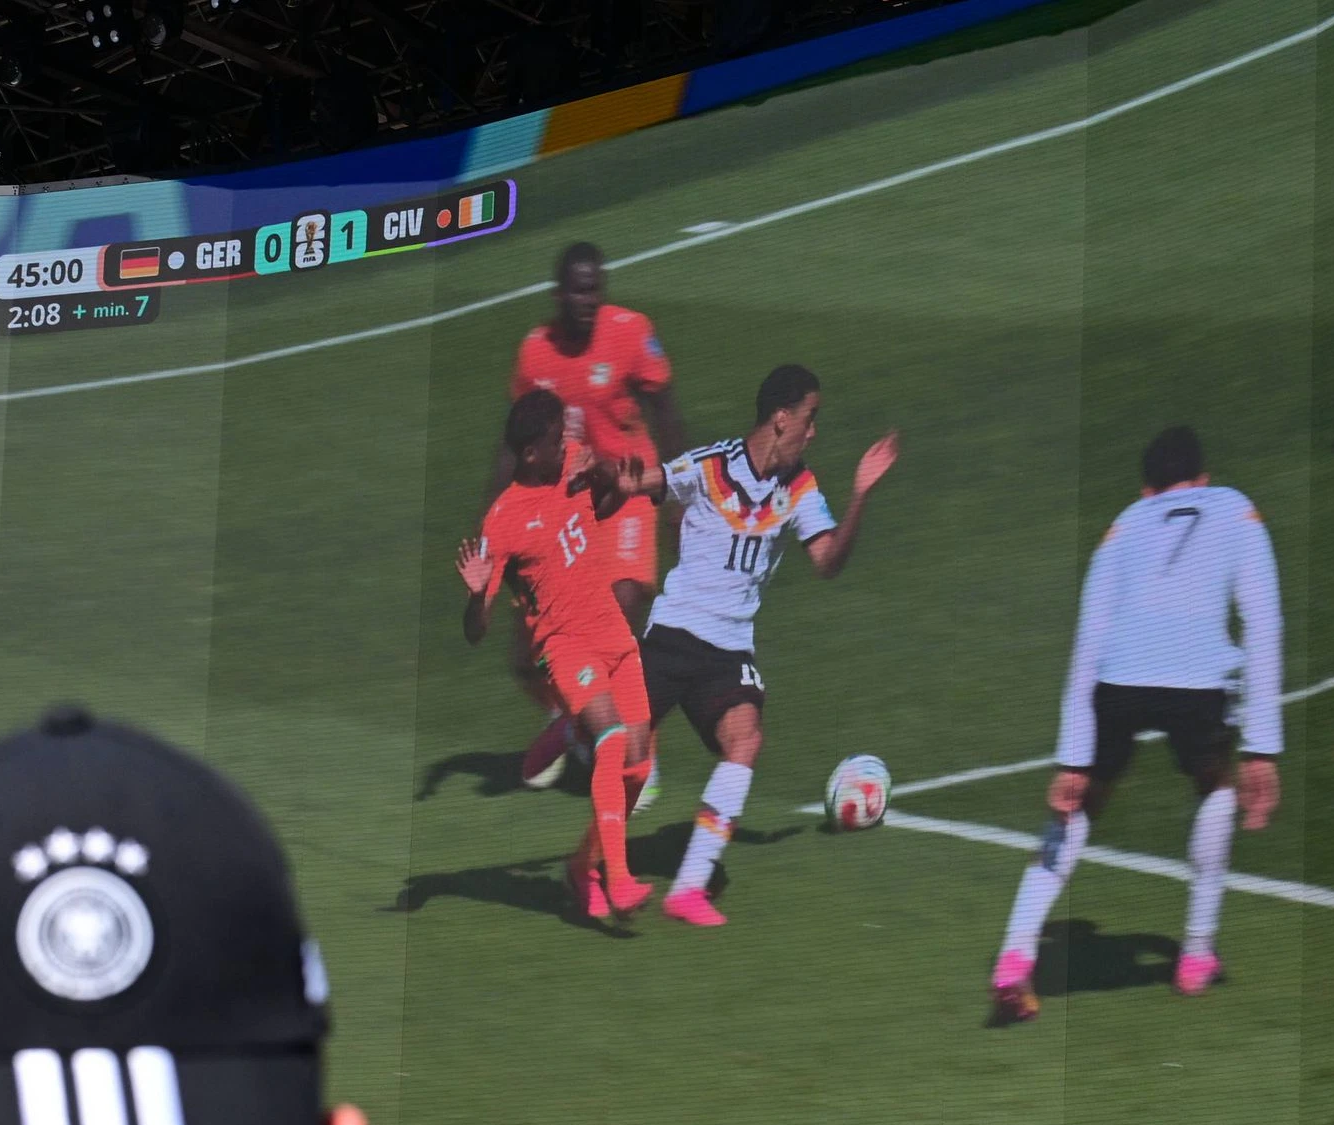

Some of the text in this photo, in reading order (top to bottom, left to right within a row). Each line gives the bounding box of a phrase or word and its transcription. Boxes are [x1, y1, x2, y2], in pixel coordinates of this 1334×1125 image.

[340, 208, 424, 250] 1 CIV
[196, 235, 282, 270] GER 0
[7, 258, 84, 289] 45:00
[8, 303, 61, 329] 2:08
[94, 301, 129, 318] min.
[135, 296, 149, 318] 7
[557, 512, 588, 569] 15
[724, 533, 763, 574] 10
[1166, 506, 1201, 564] 7
